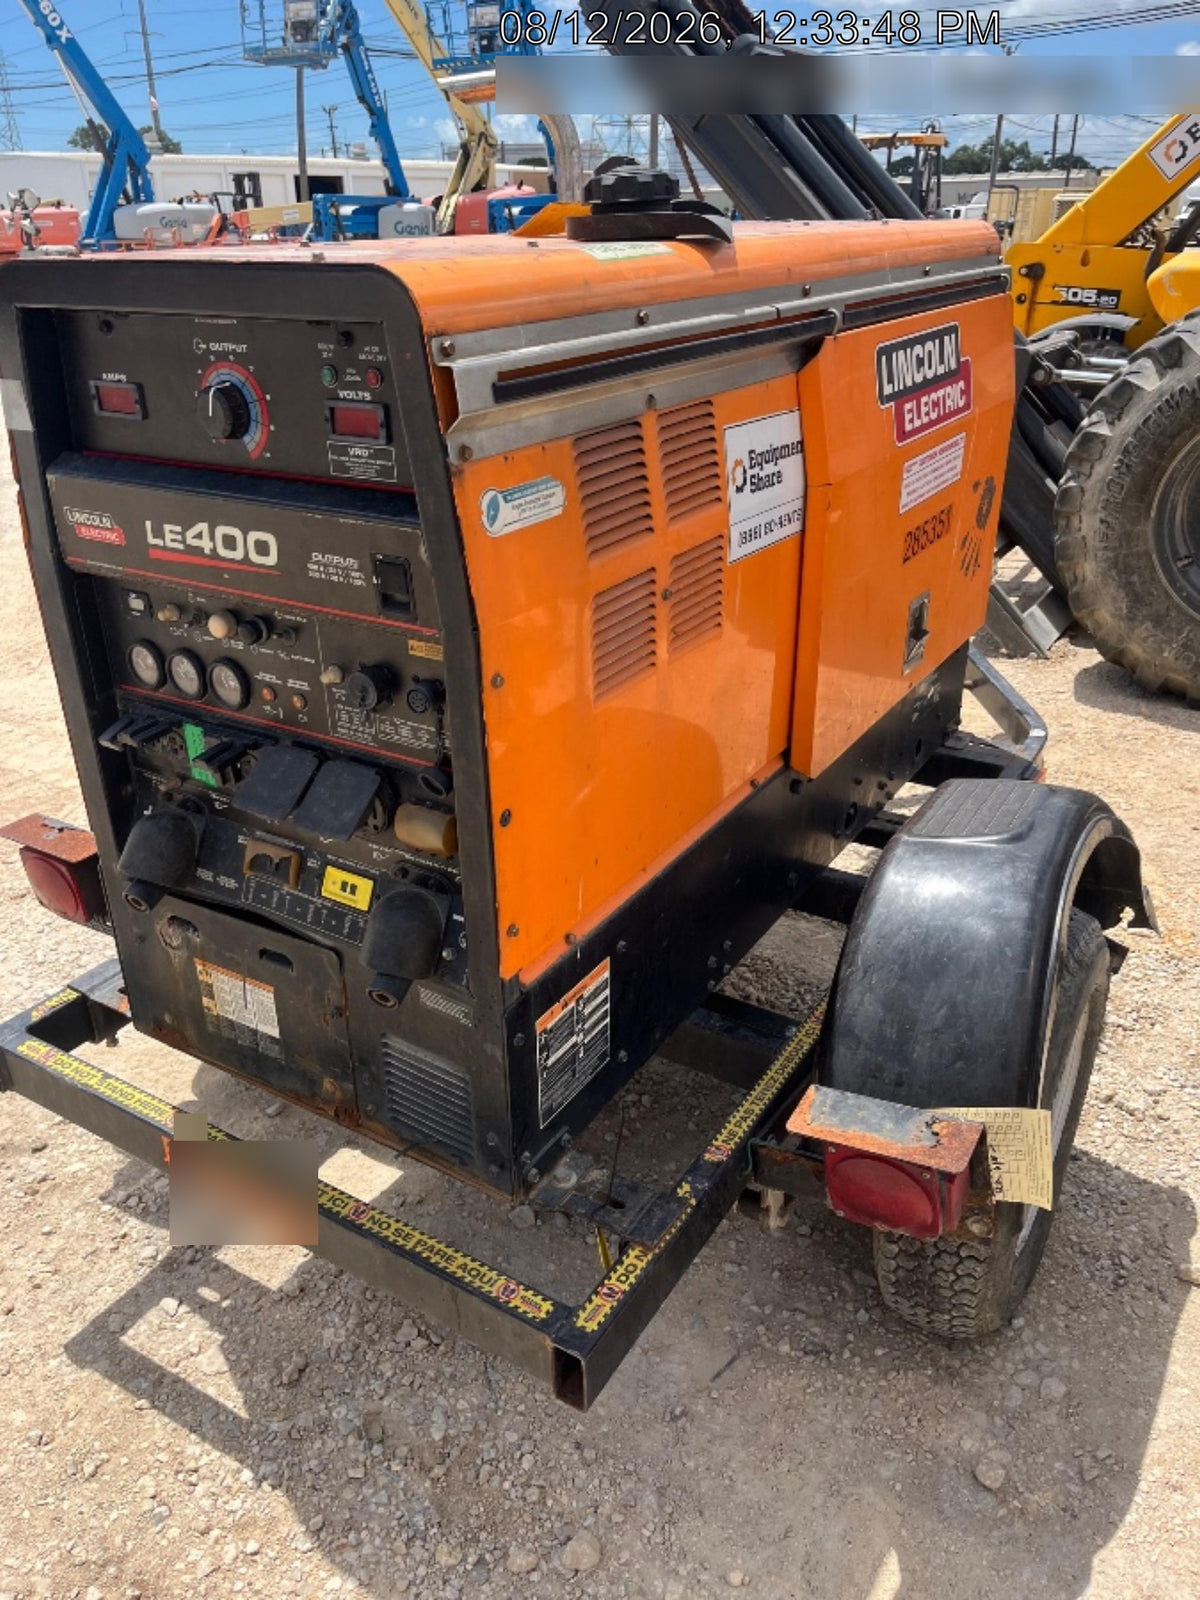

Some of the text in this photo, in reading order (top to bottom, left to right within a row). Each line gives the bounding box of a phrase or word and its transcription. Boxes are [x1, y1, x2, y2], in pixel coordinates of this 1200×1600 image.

[394, 220, 429, 236] Genie
[208, 342, 248, 353] OUTPUT
[881, 334, 958, 396] LINCOLN
[337, 389, 372, 401] VOLTS
[904, 380, 967, 433] ELECTRIC
[748, 440, 804, 471] Equipmen
[750, 470, 783, 494] Share
[68, 508, 112, 529] LINCOLN
[81, 525, 120, 542] ELECTRIC
[145, 520, 279, 567] LE400
[53, 1056, 169, 1117] DO NOT STAND HERE
[326, 1194, 349, 1210] ICI
[366, 1215, 391, 1232] NO
[392, 1228, 413, 1244] SE
[414, 1238, 457, 1267] PARE
[616, 1262, 638, 1283] DO
